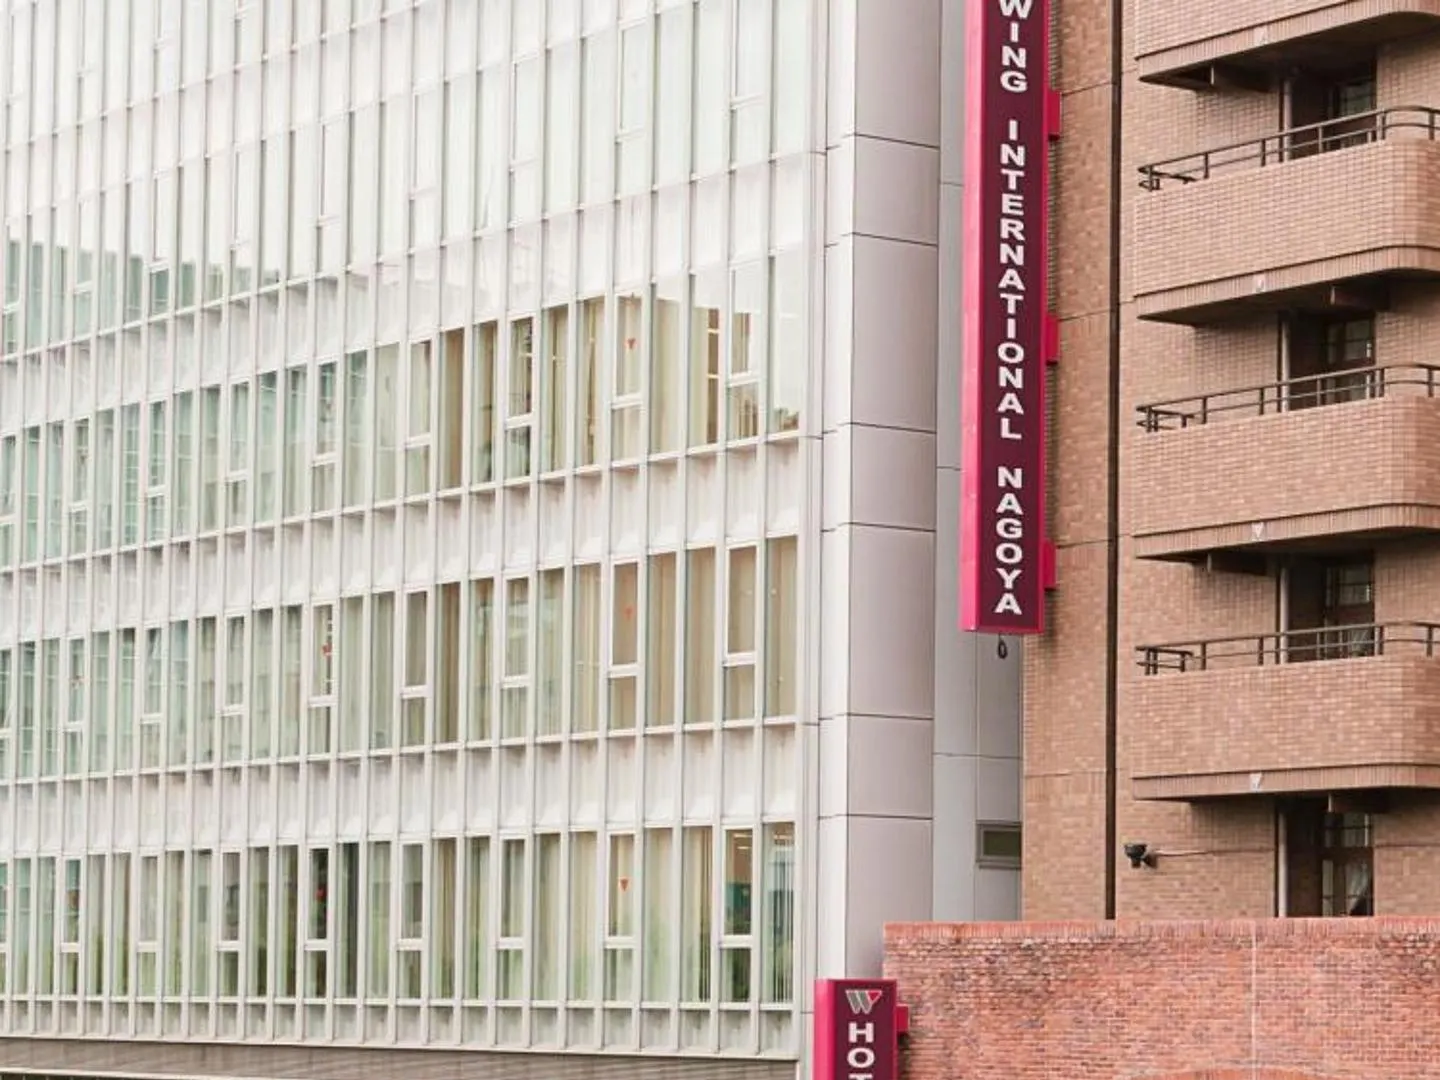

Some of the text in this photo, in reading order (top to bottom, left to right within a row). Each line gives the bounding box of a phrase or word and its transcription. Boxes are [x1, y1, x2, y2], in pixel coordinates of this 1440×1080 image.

[995, 0, 1032, 615] WING INTERNATIONAL NAGOYA
